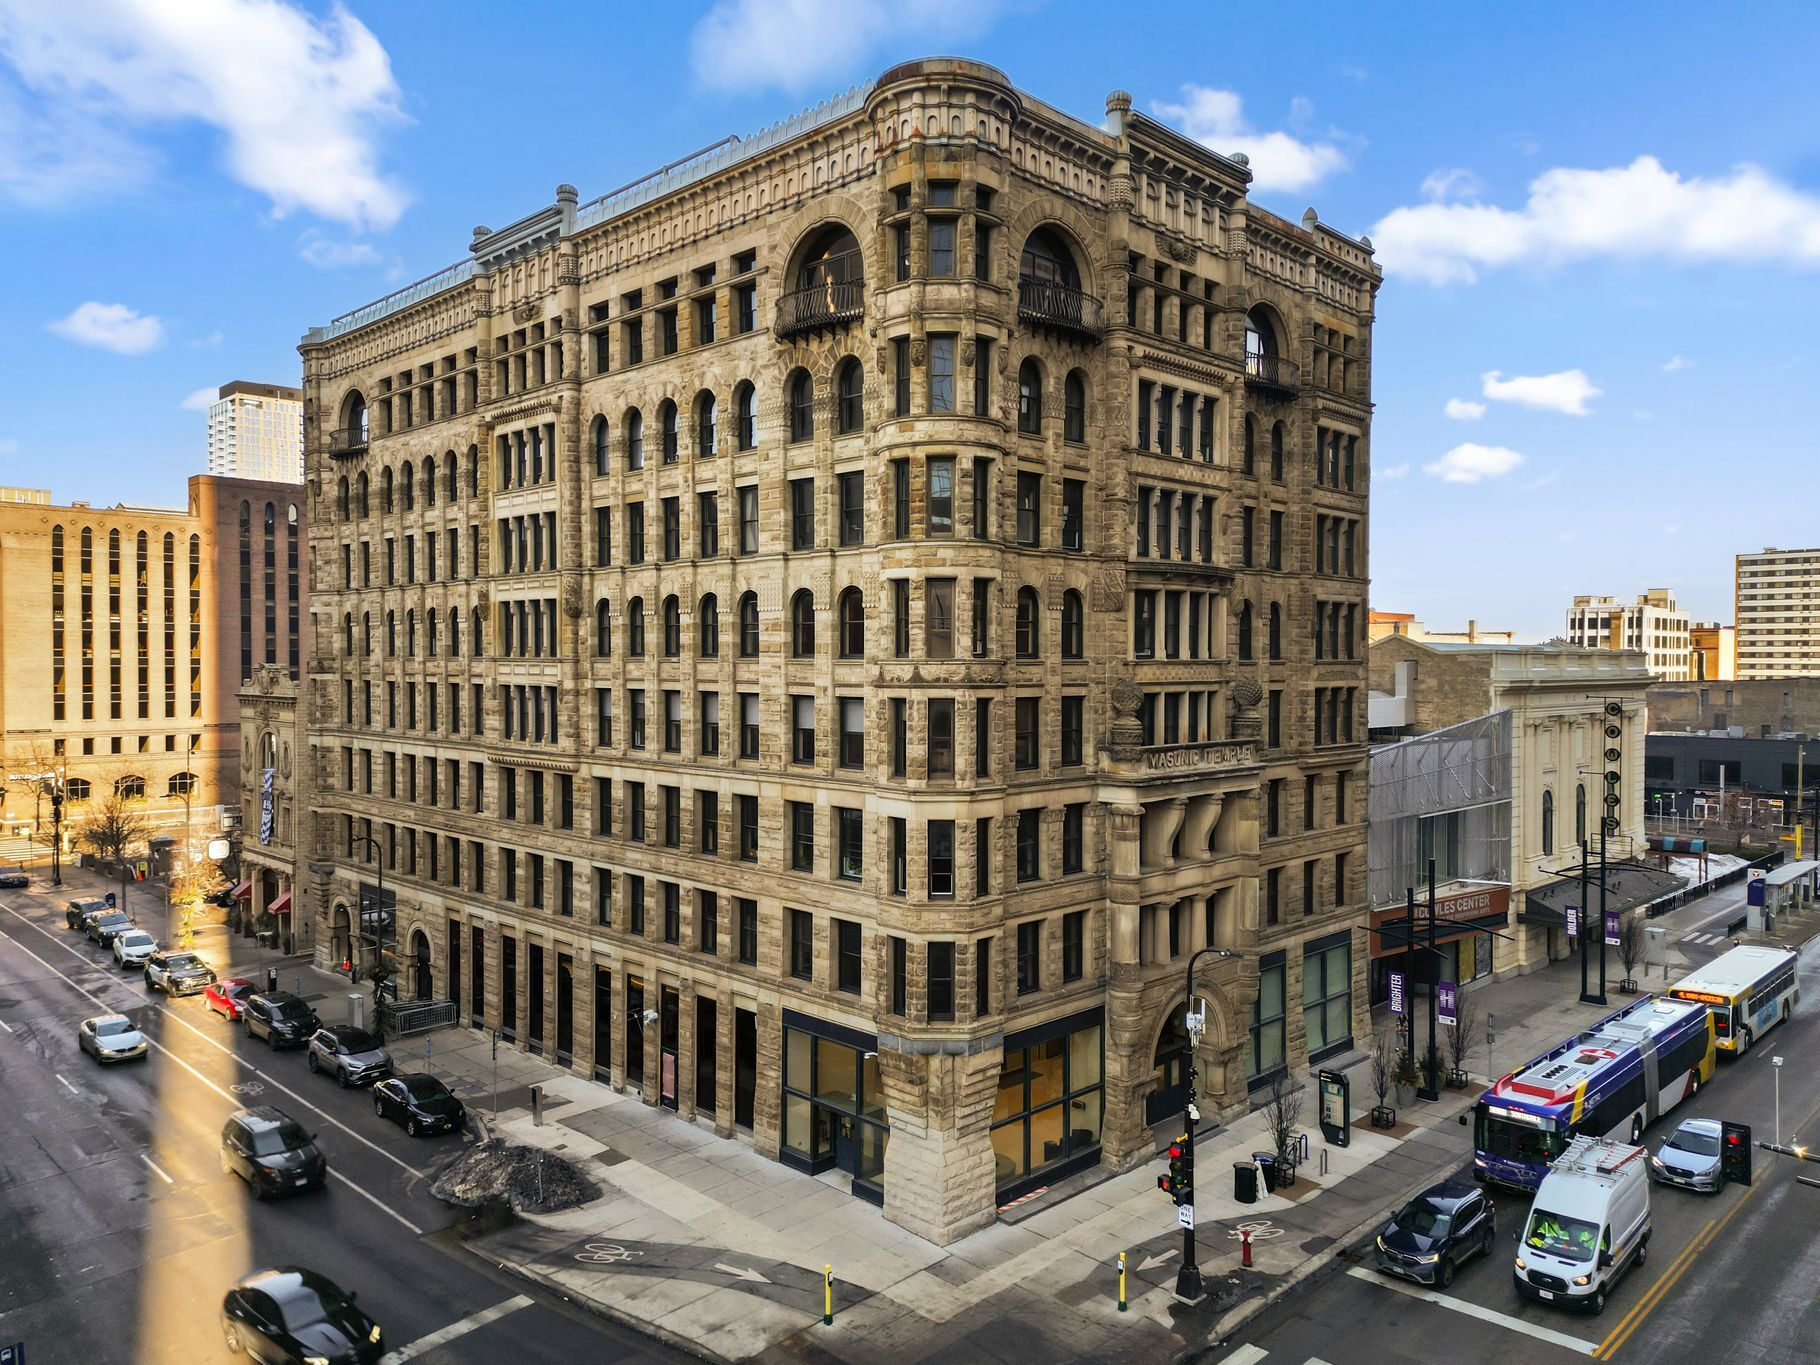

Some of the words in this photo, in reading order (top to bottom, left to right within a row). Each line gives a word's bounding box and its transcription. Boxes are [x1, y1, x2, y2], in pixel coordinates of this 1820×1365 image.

[1150, 750, 1200, 768] MASONIC
[1205, 745, 1251, 763] TEMPLE
[1605, 703, 1620, 830] COWLES
[1456, 894, 1490, 911] CENTER
[1567, 909, 1577, 935] BOLDER
[1391, 974, 1401, 1012] BRIGHTER
[1180, 1211, 1191, 1219] WAY
